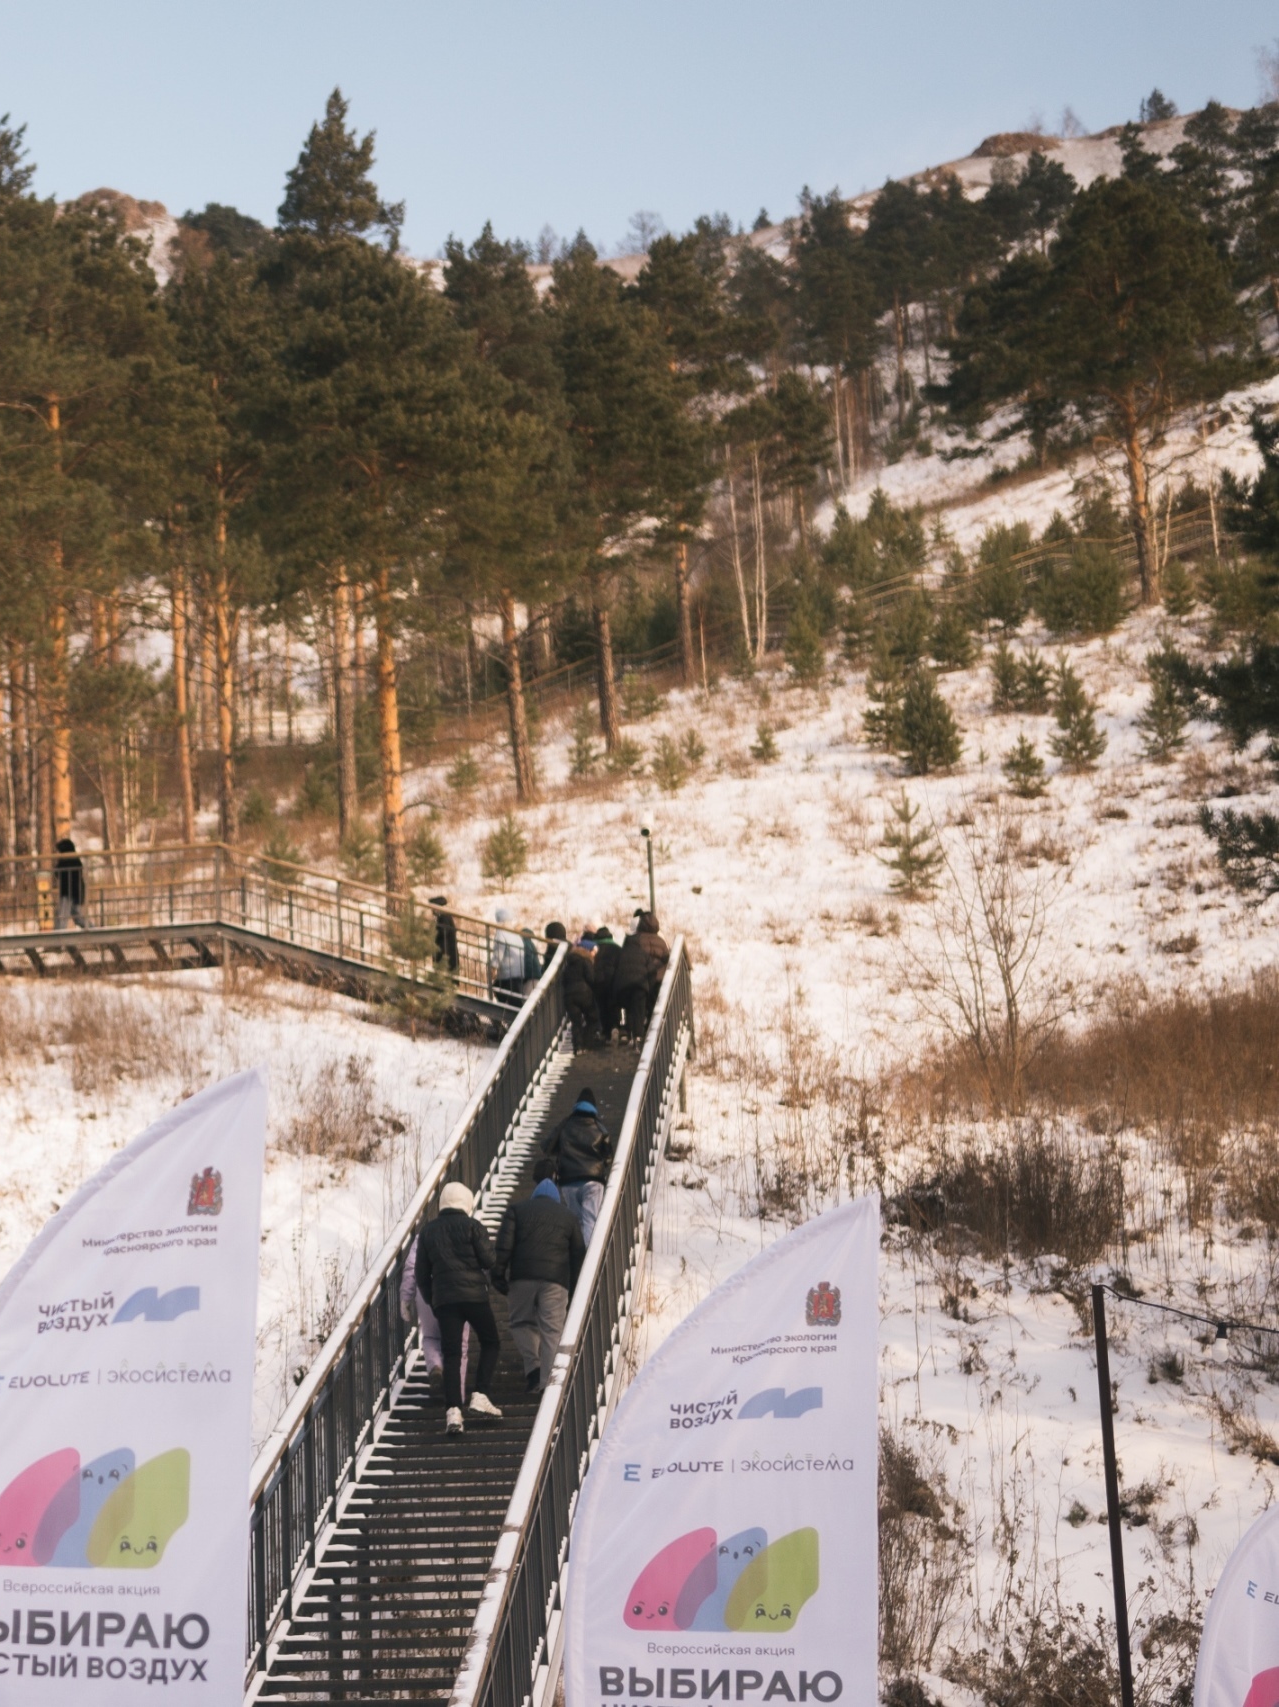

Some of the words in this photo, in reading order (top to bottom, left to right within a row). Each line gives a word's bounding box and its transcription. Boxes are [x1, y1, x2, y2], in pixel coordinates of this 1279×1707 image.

[82, 1228, 162, 1248] Минерство
[103, 1237, 183, 1256] расноярского
[187, 1237, 217, 1248] края
[38, 1291, 114, 1317] ЧИСТЫЙ
[37, 1313, 109, 1334] ВОЗДУХ
[784, 1333, 837, 1343] экологии
[732, 1345, 807, 1365] Краярского
[810, 1344, 837, 1354] края
[3, 1579, 114, 1595] Всероссийская
[118, 1584, 161, 1597] акция
[647, 1642, 751, 1656] Всероссийская
[755, 1646, 795, 1657] акция
[86, 1656, 208, 1685] ВОЗДУХ
[599, 1666, 843, 1703] ВЫБИРАЮ
